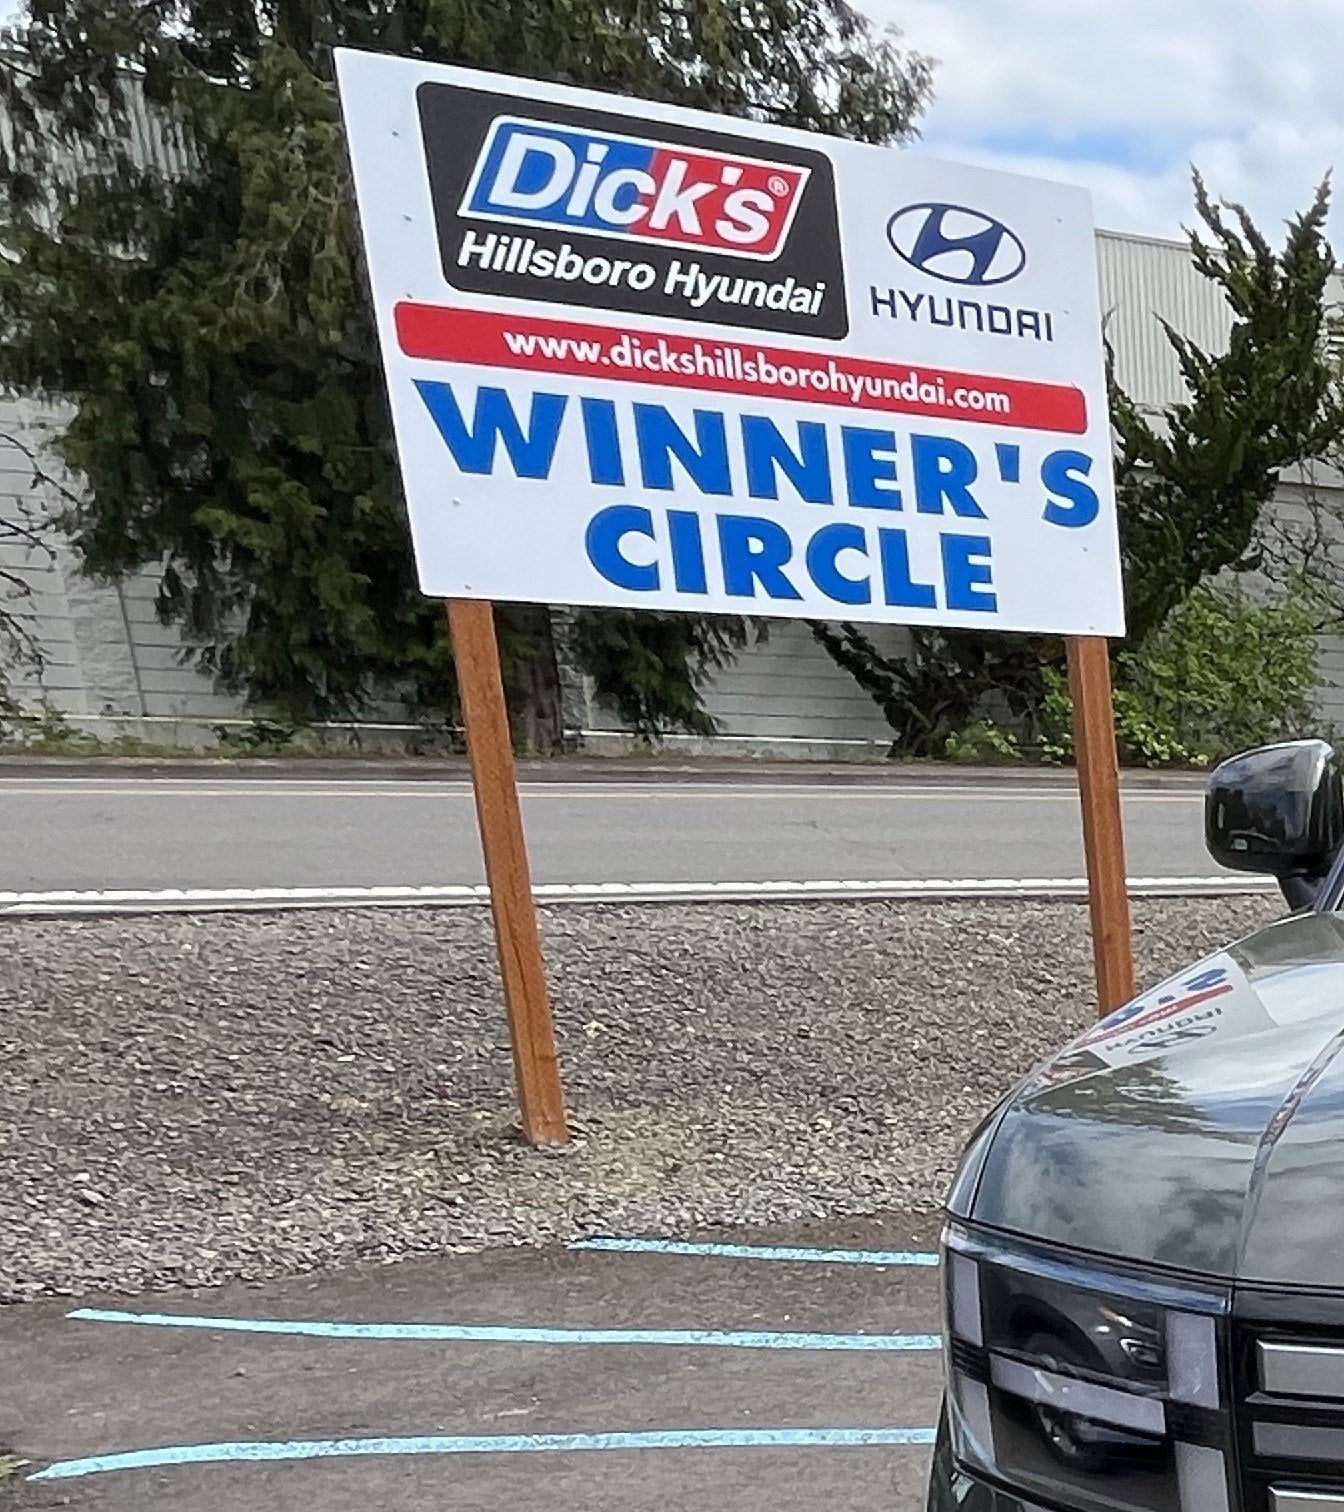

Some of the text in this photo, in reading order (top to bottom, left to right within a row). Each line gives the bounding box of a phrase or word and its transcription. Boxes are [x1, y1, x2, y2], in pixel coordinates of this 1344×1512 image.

[457, 230, 826, 316] Hillsboro Hyundai
[870, 286, 1053, 342] HYUNDAI
[503, 326, 1011, 415] www.dickshillsborohyundai.com
[411, 378, 1100, 529] WINNER'S
[584, 504, 999, 613] CIRCLE
